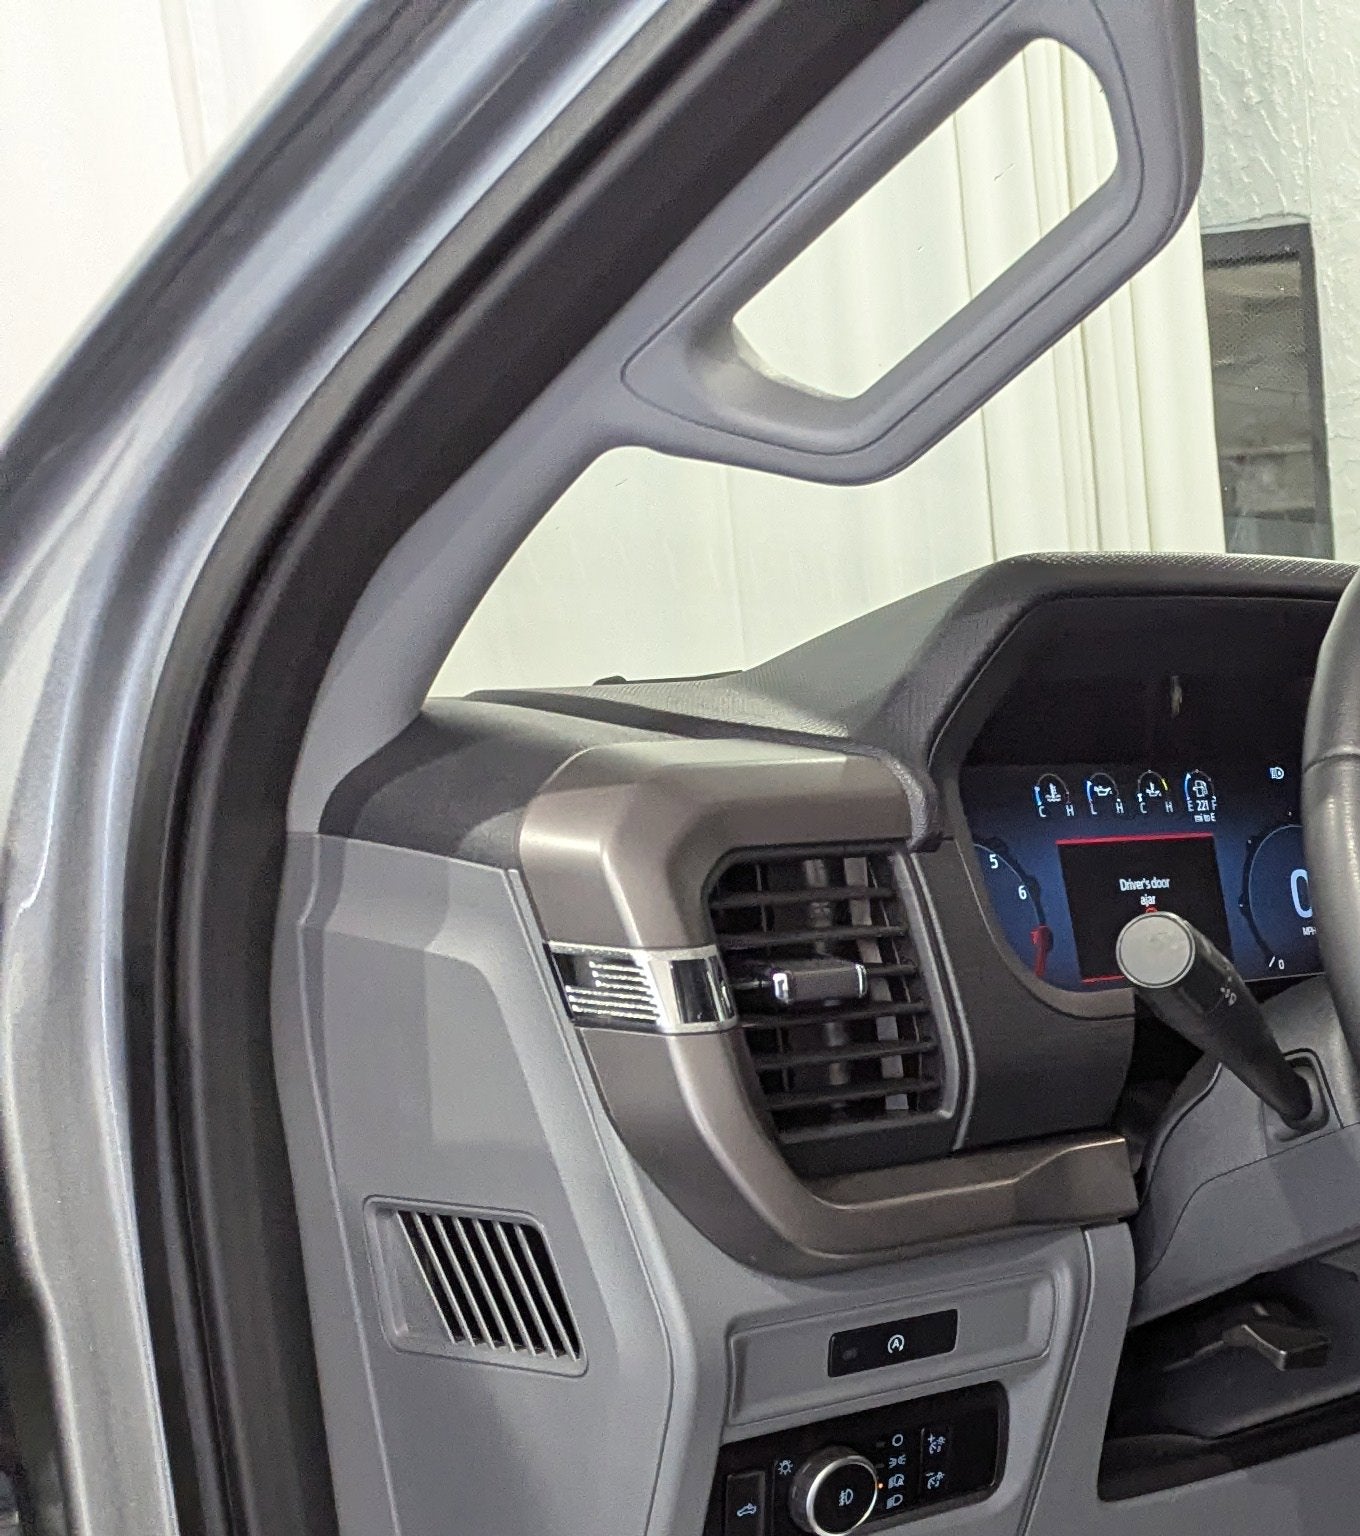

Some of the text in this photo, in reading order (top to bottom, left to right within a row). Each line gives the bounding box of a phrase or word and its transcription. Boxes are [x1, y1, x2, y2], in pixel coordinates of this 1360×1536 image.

[989, 853, 999, 870] 5
[1119, 876, 1170, 891] Driver's door
[1017, 884, 1027, 900] 6
[1140, 893, 1156, 907] ajar
